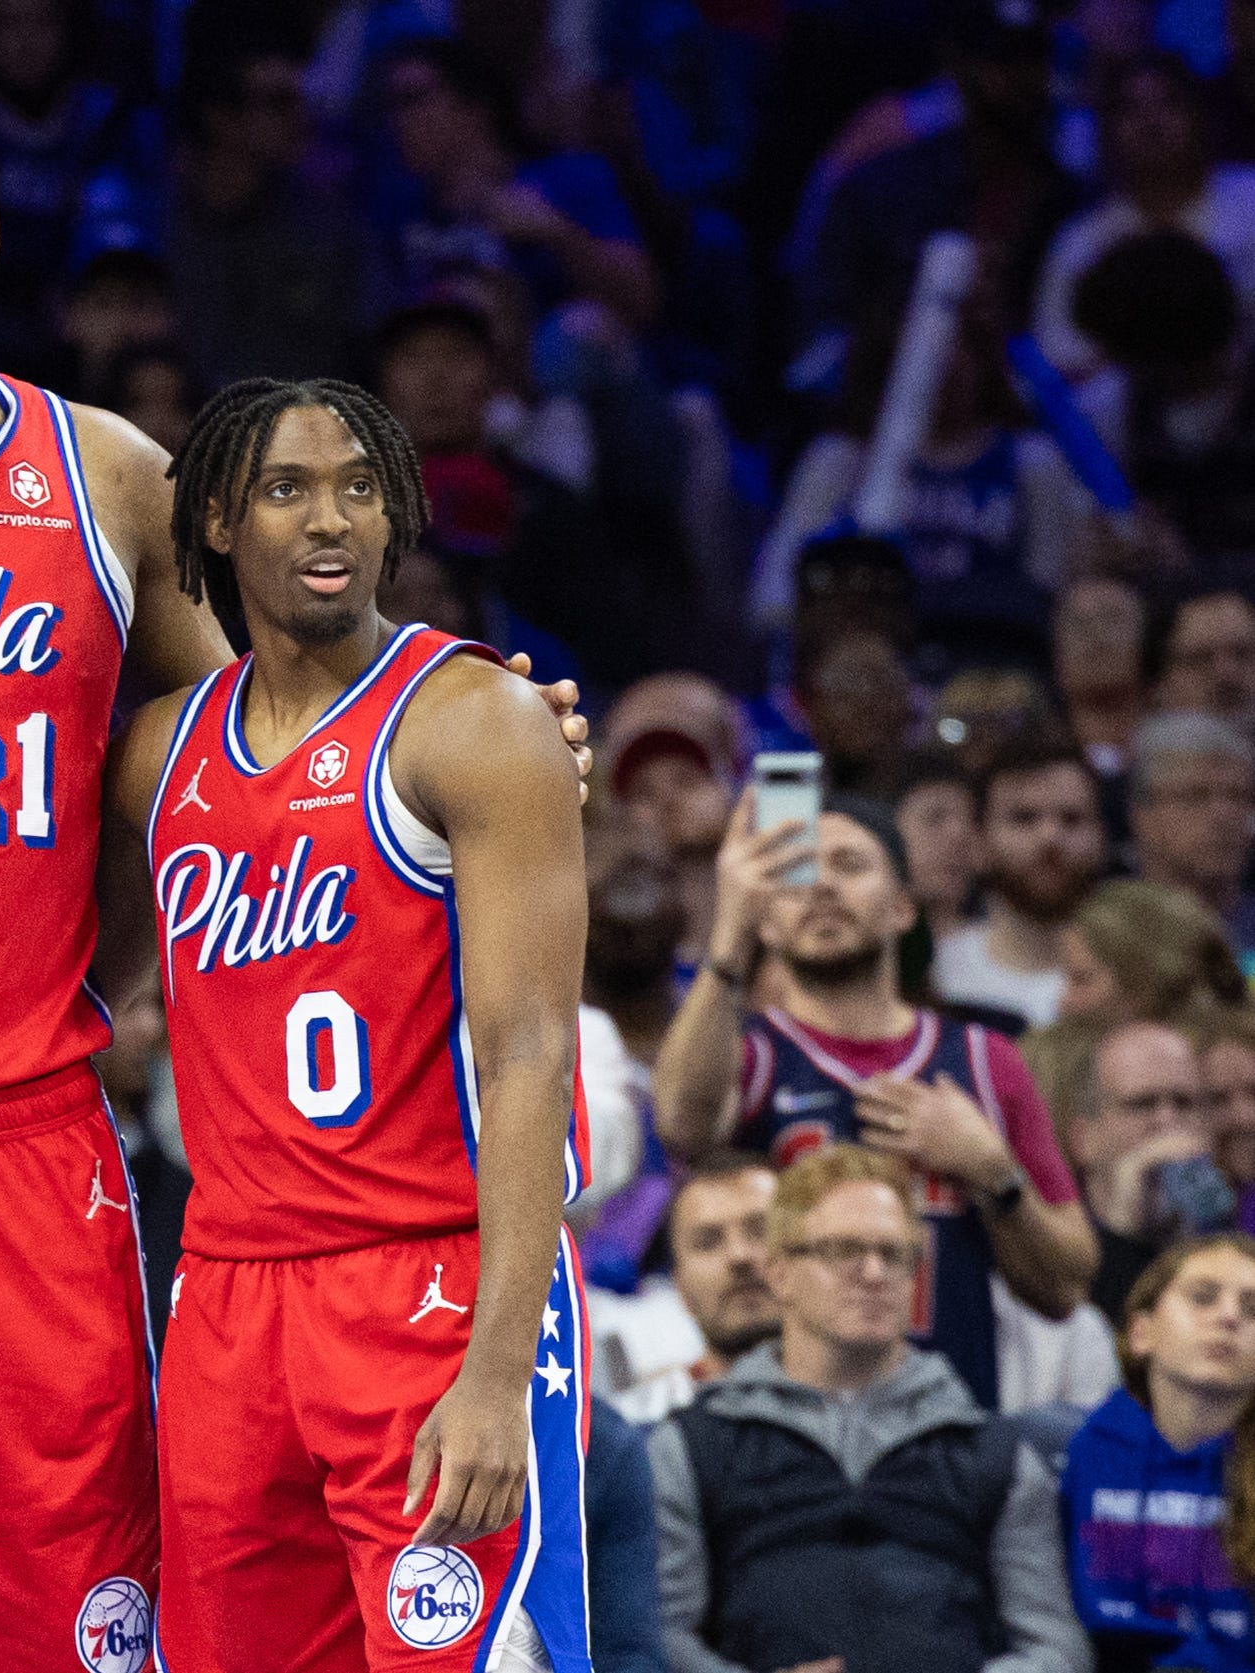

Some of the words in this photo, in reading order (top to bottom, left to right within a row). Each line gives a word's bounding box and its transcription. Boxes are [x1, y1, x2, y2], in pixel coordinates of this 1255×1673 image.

[289, 792, 355, 811] crypto.com
[157, 835, 356, 1008] Phila
[286, 990, 371, 1129] 0
[396, 1583, 471, 1621] 76ers
